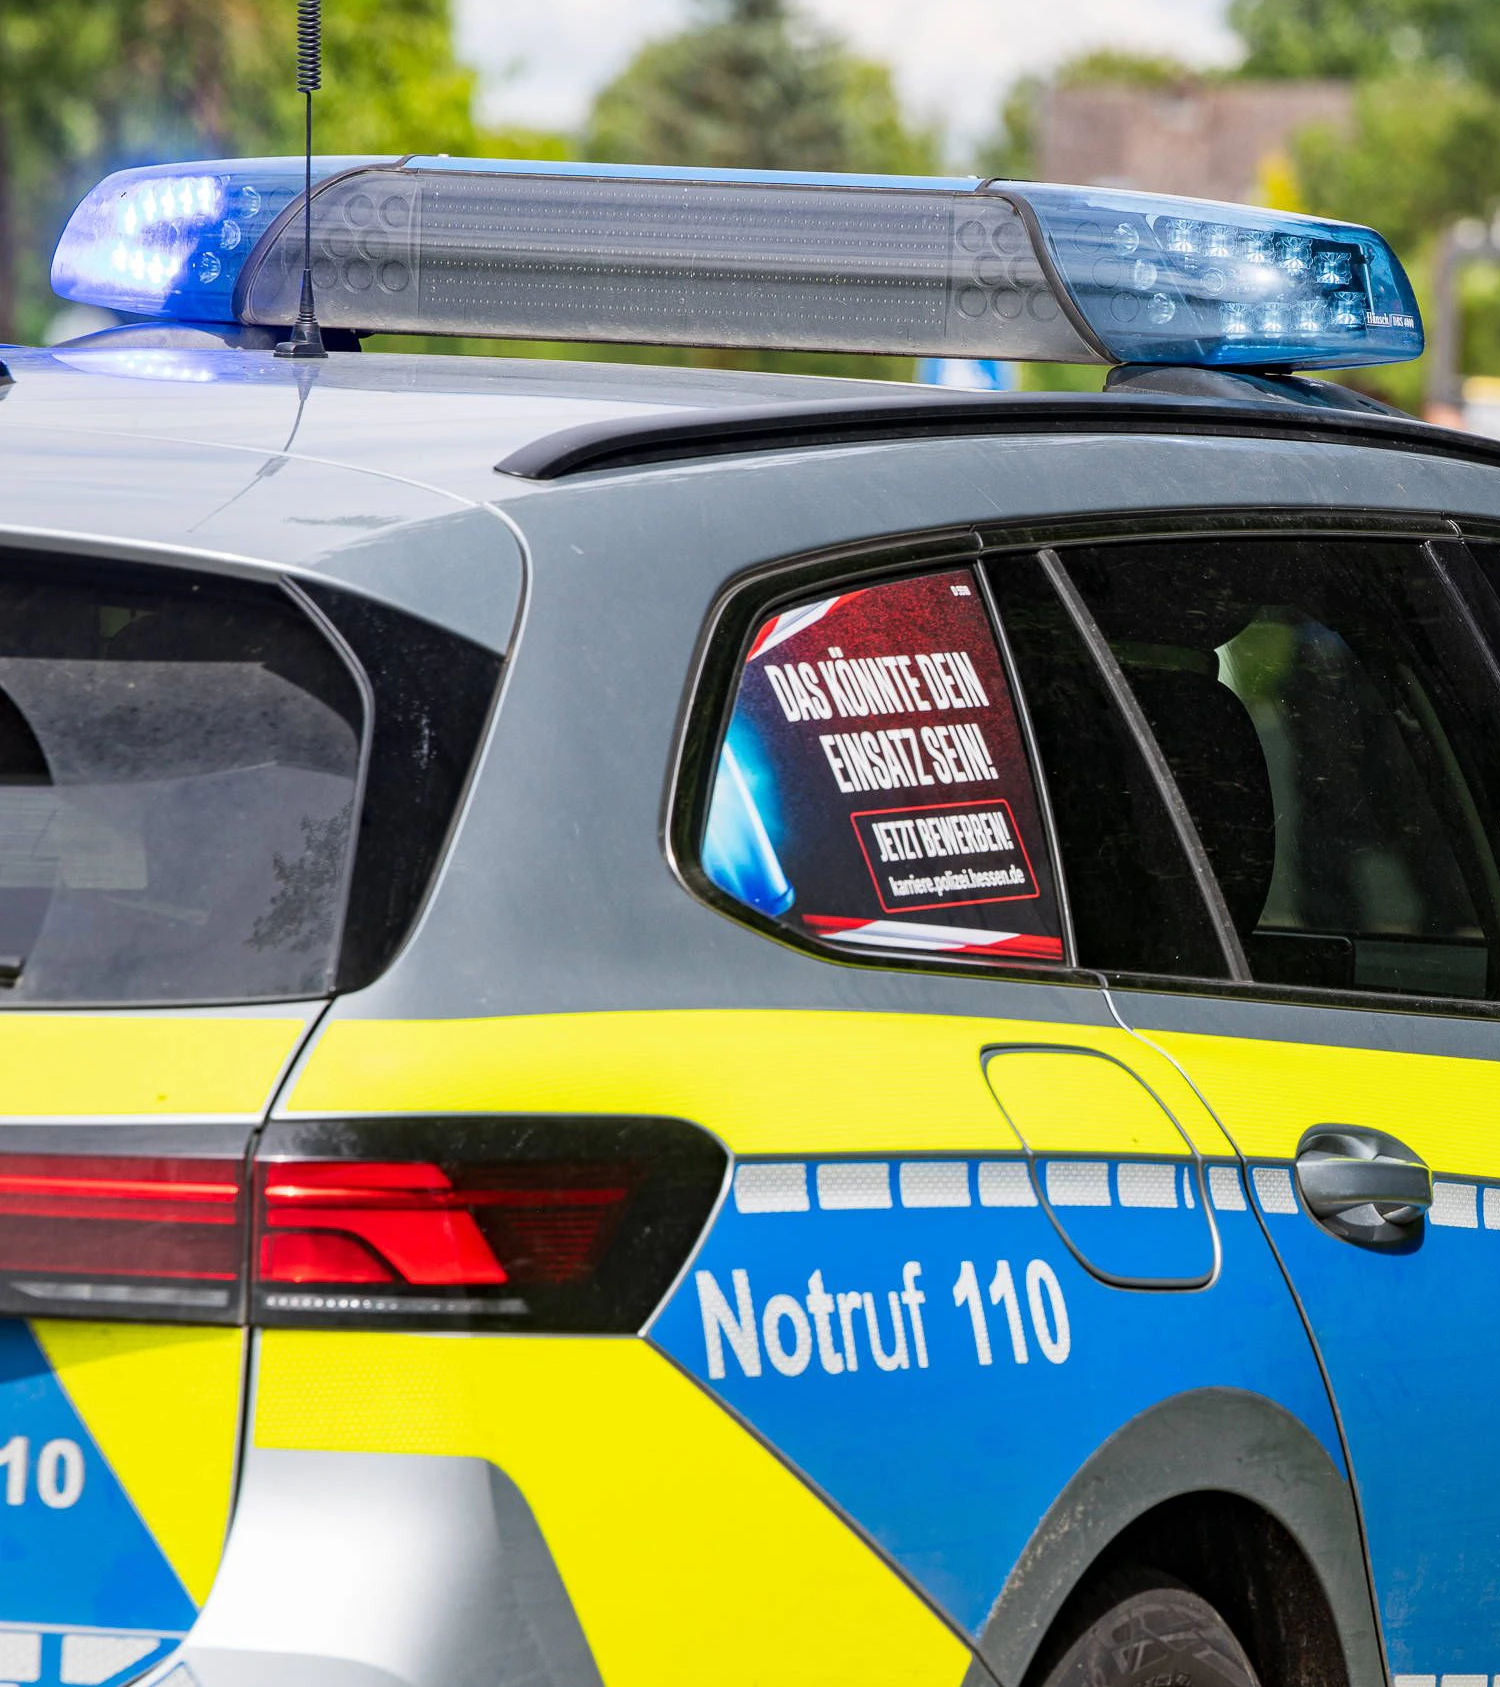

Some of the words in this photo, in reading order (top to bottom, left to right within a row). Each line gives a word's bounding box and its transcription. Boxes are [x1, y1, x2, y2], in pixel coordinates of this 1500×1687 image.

[764, 661, 832, 722] DAS
[817, 647, 931, 718] KÖNNTE
[914, 651, 989, 710] DEIN
[819, 728, 935, 793] EINSATZ
[920, 723, 999, 784] SEIN!
[872, 819, 923, 862] JETZT
[915, 812, 1014, 857] BEWERBEN!
[888, 864, 1025, 897] karriere.polizei.hessen.de
[695, 1261, 929, 1380] Notruf
[953, 1258, 1071, 1366] 110
